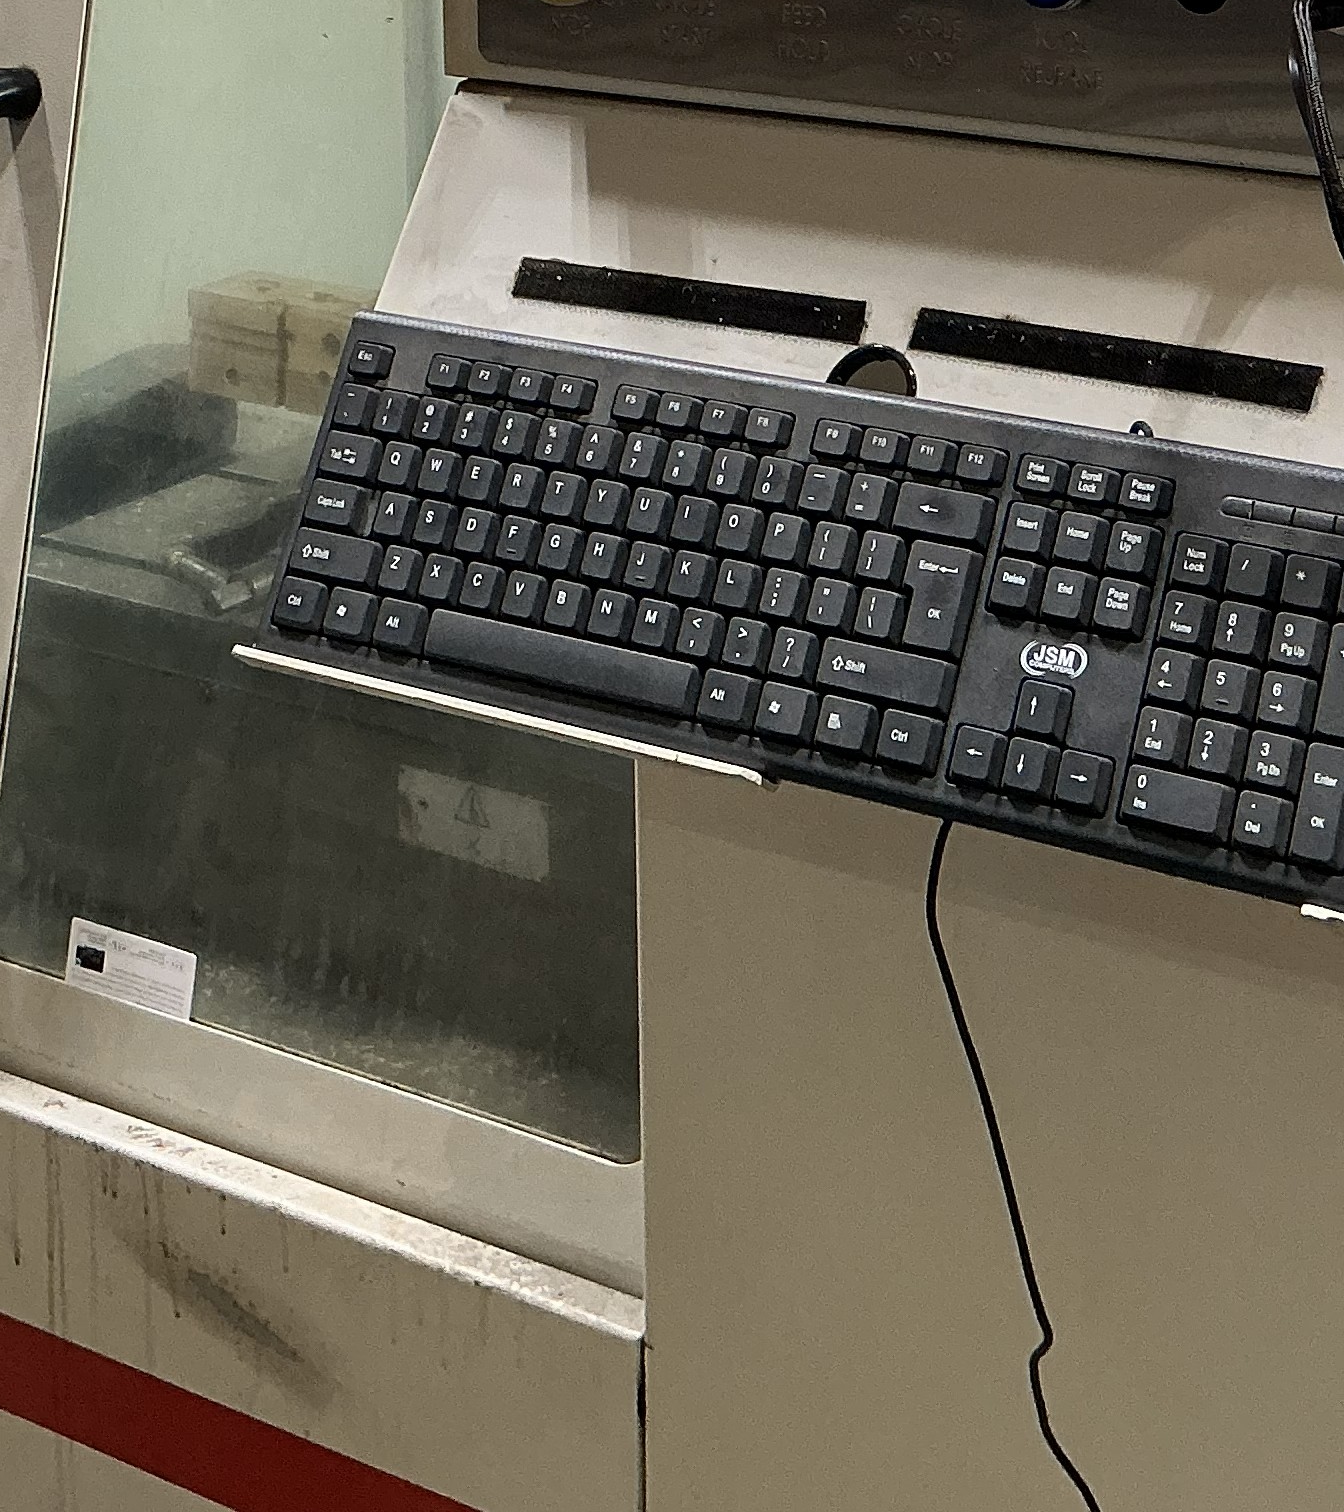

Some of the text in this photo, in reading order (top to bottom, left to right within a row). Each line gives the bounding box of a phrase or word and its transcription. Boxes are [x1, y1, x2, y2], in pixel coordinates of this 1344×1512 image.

[391, 451, 401, 466] Q
[430, 459, 442, 472] W
[471, 466, 480, 479] E
[513, 473, 521, 487] R
[555, 481, 564, 495] T
[597, 489, 606, 502] Y
[385, 503, 395, 515] A
[426, 511, 434, 523] S
[466, 518, 477, 532] D
[551, 535, 560, 547] G
[593, 542, 603, 556] H
[391, 557, 399, 570] Z
[680, 561, 691, 574] K
[430, 565, 442, 577] X
[473, 574, 482, 586] C
[515, 582, 524, 596] V
[556, 590, 567, 605] B
[601, 600, 612, 614] N
[645, 610, 656, 623] M
[1033, 645, 1076, 666] JSM
[891, 729, 908, 742] Ctrl
